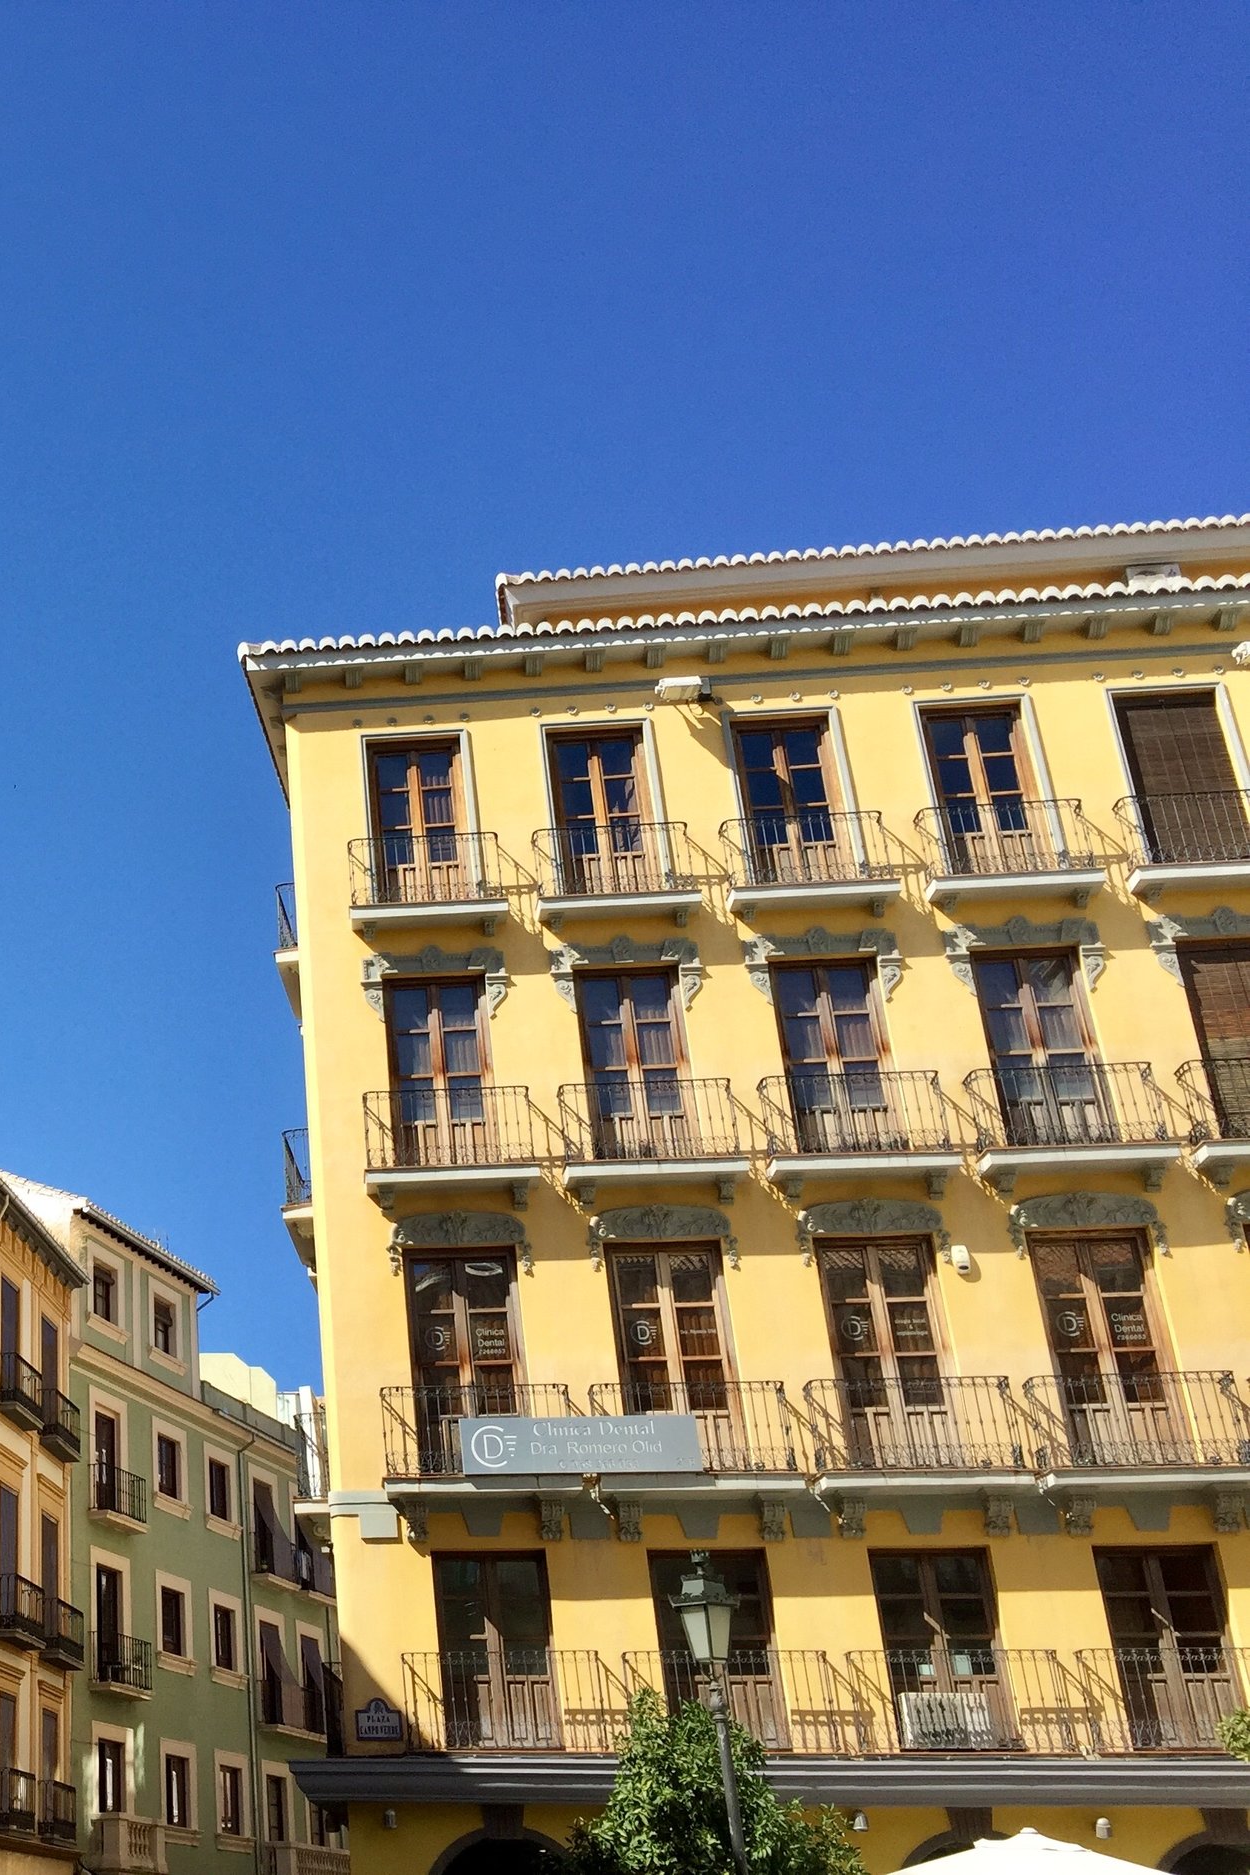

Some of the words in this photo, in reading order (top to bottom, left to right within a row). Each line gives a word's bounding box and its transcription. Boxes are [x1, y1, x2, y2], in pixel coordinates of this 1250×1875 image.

[1114, 1323, 1145, 1333] Dental
[477, 1339, 505, 1347] Dental
[598, 1420, 655, 1436] Dental
[566, 1441, 628, 1454] Romero
[631, 1439, 663, 1454] Olid
[366, 1715, 391, 1723] PLAZA
